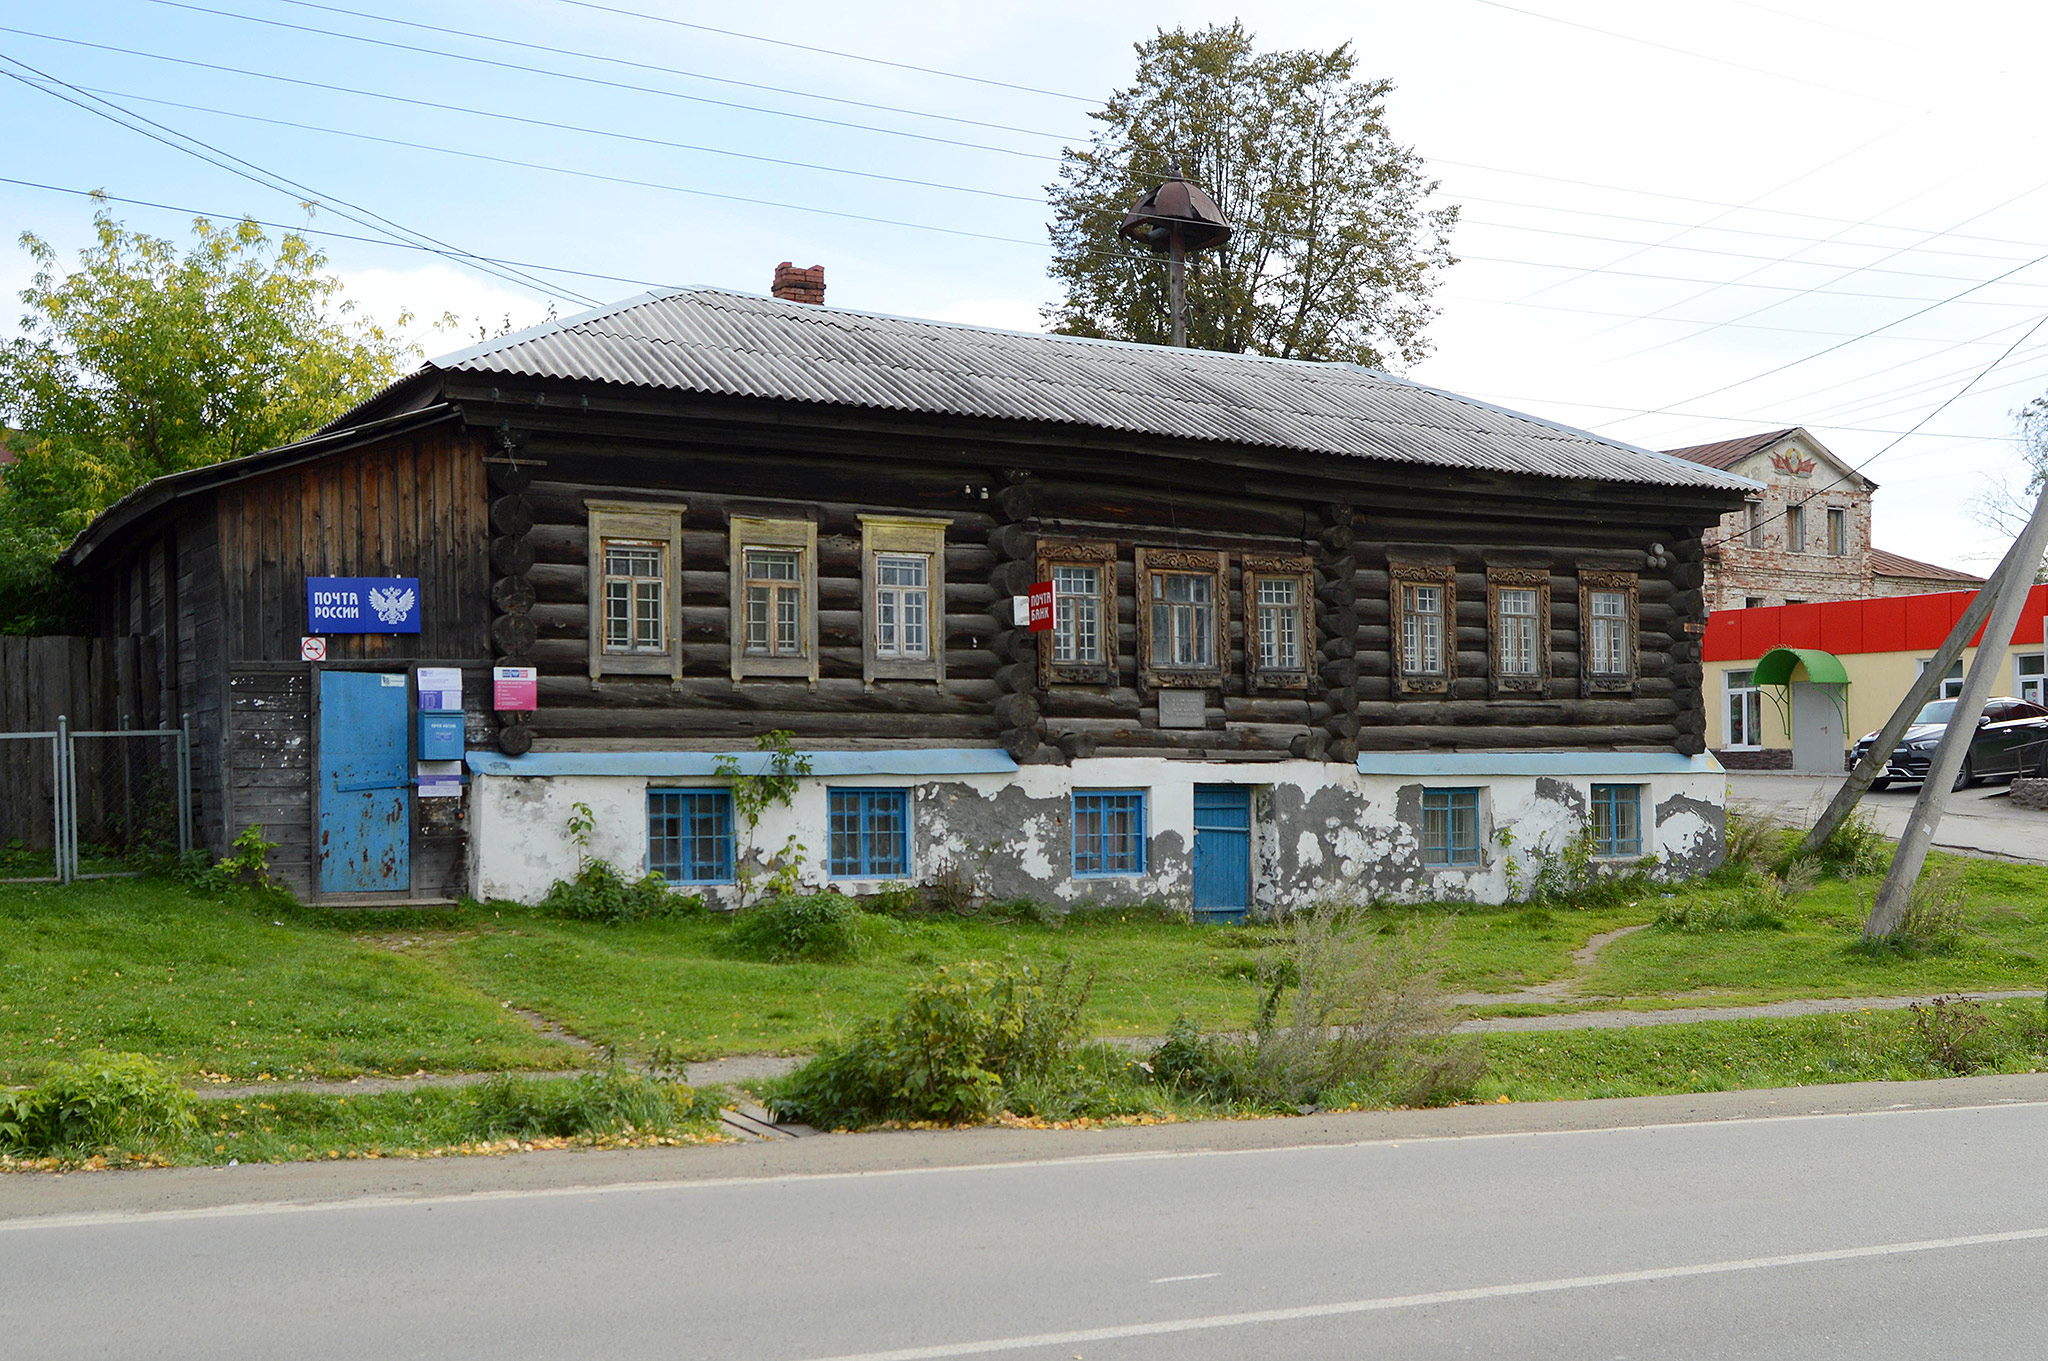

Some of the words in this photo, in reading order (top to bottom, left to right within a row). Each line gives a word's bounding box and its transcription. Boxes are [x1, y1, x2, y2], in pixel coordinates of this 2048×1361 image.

[314, 592, 358, 605] ПОЧТА
[1031, 592, 1051, 607] ПОЧТА
[315, 606, 359, 619] РОССИИ
[1031, 607, 1049, 621] БАНК
